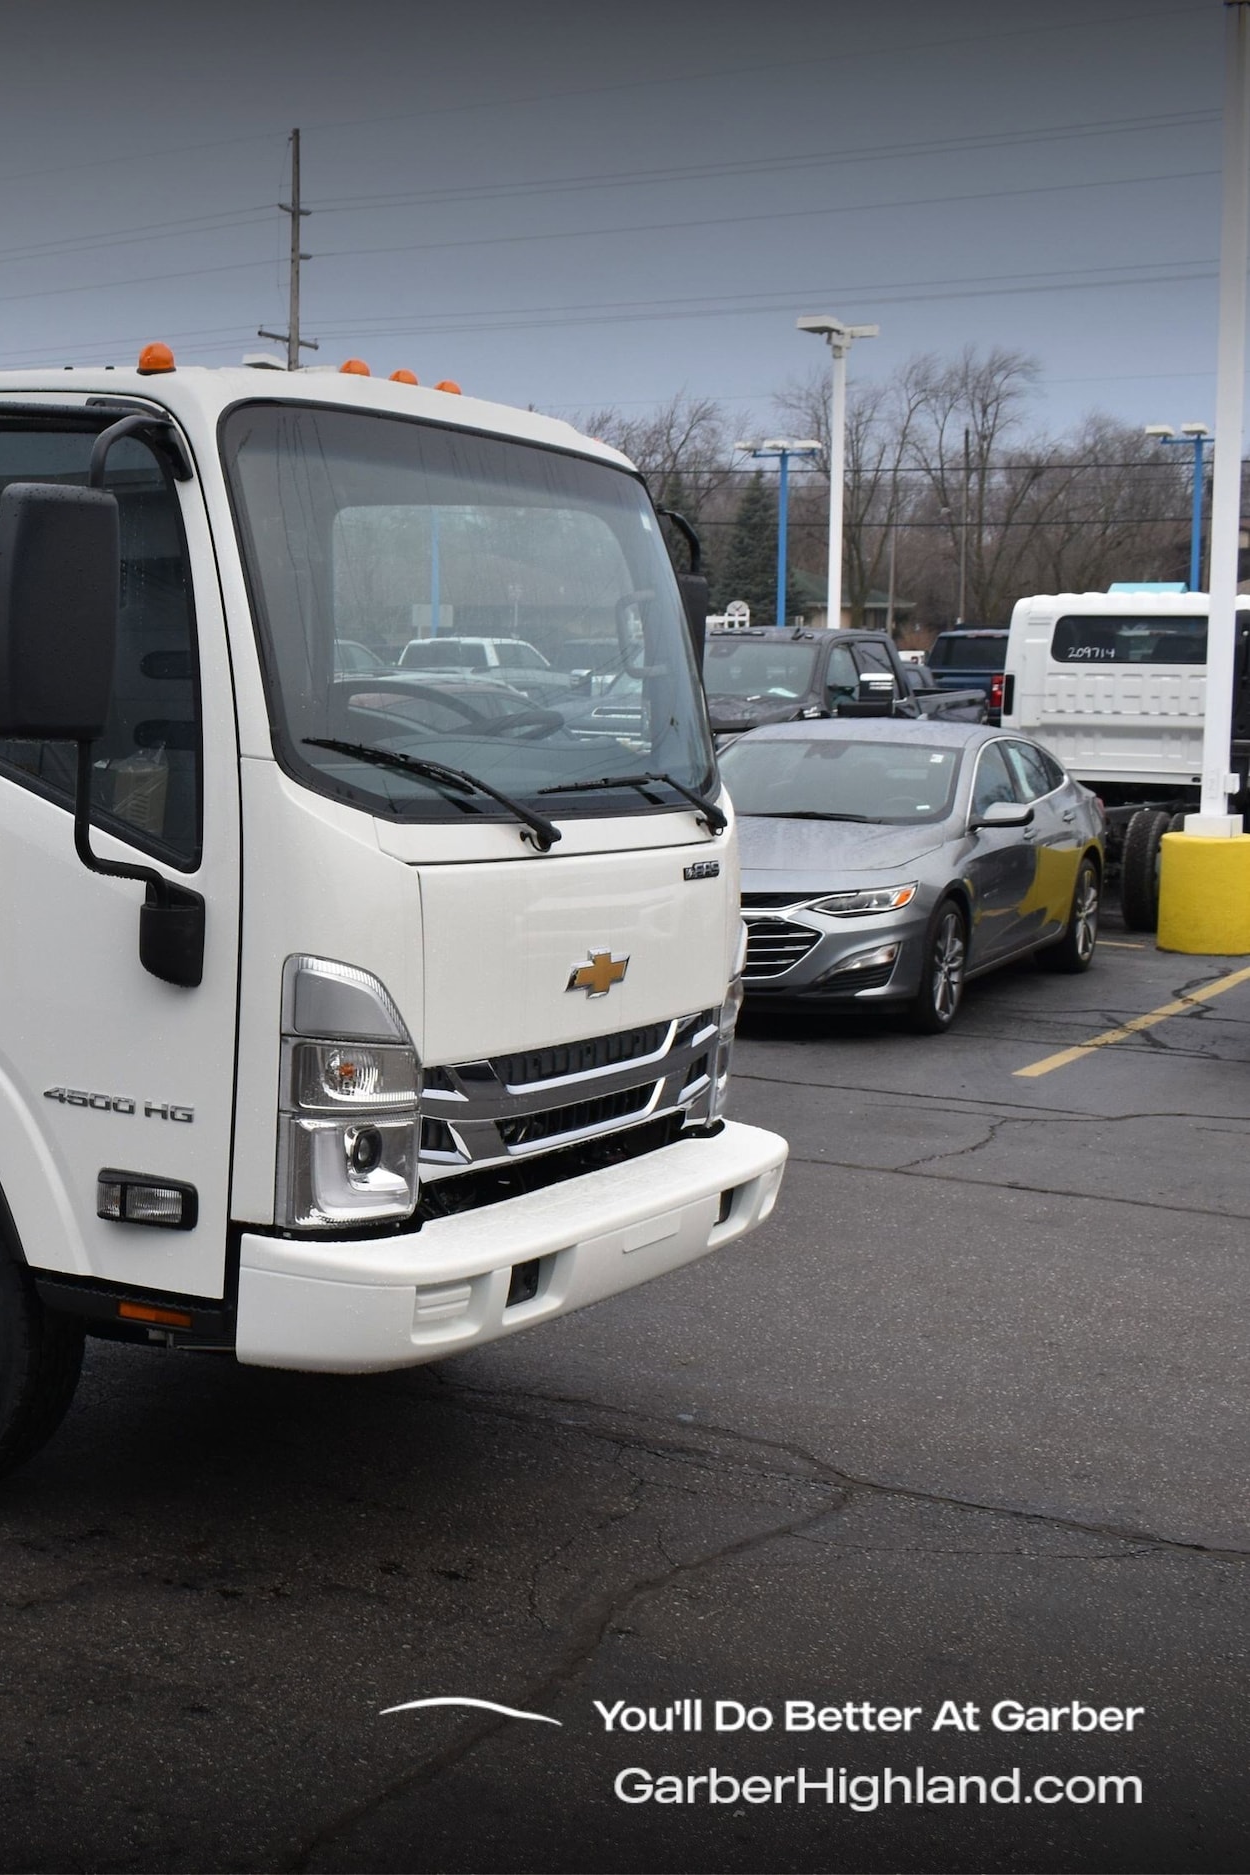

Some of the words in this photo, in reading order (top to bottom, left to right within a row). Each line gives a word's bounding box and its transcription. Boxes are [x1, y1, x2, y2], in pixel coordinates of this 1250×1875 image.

[1067, 647, 1116, 659] 209714
[43, 1086, 136, 1115] 4500
[144, 1101, 195, 1123] HG
